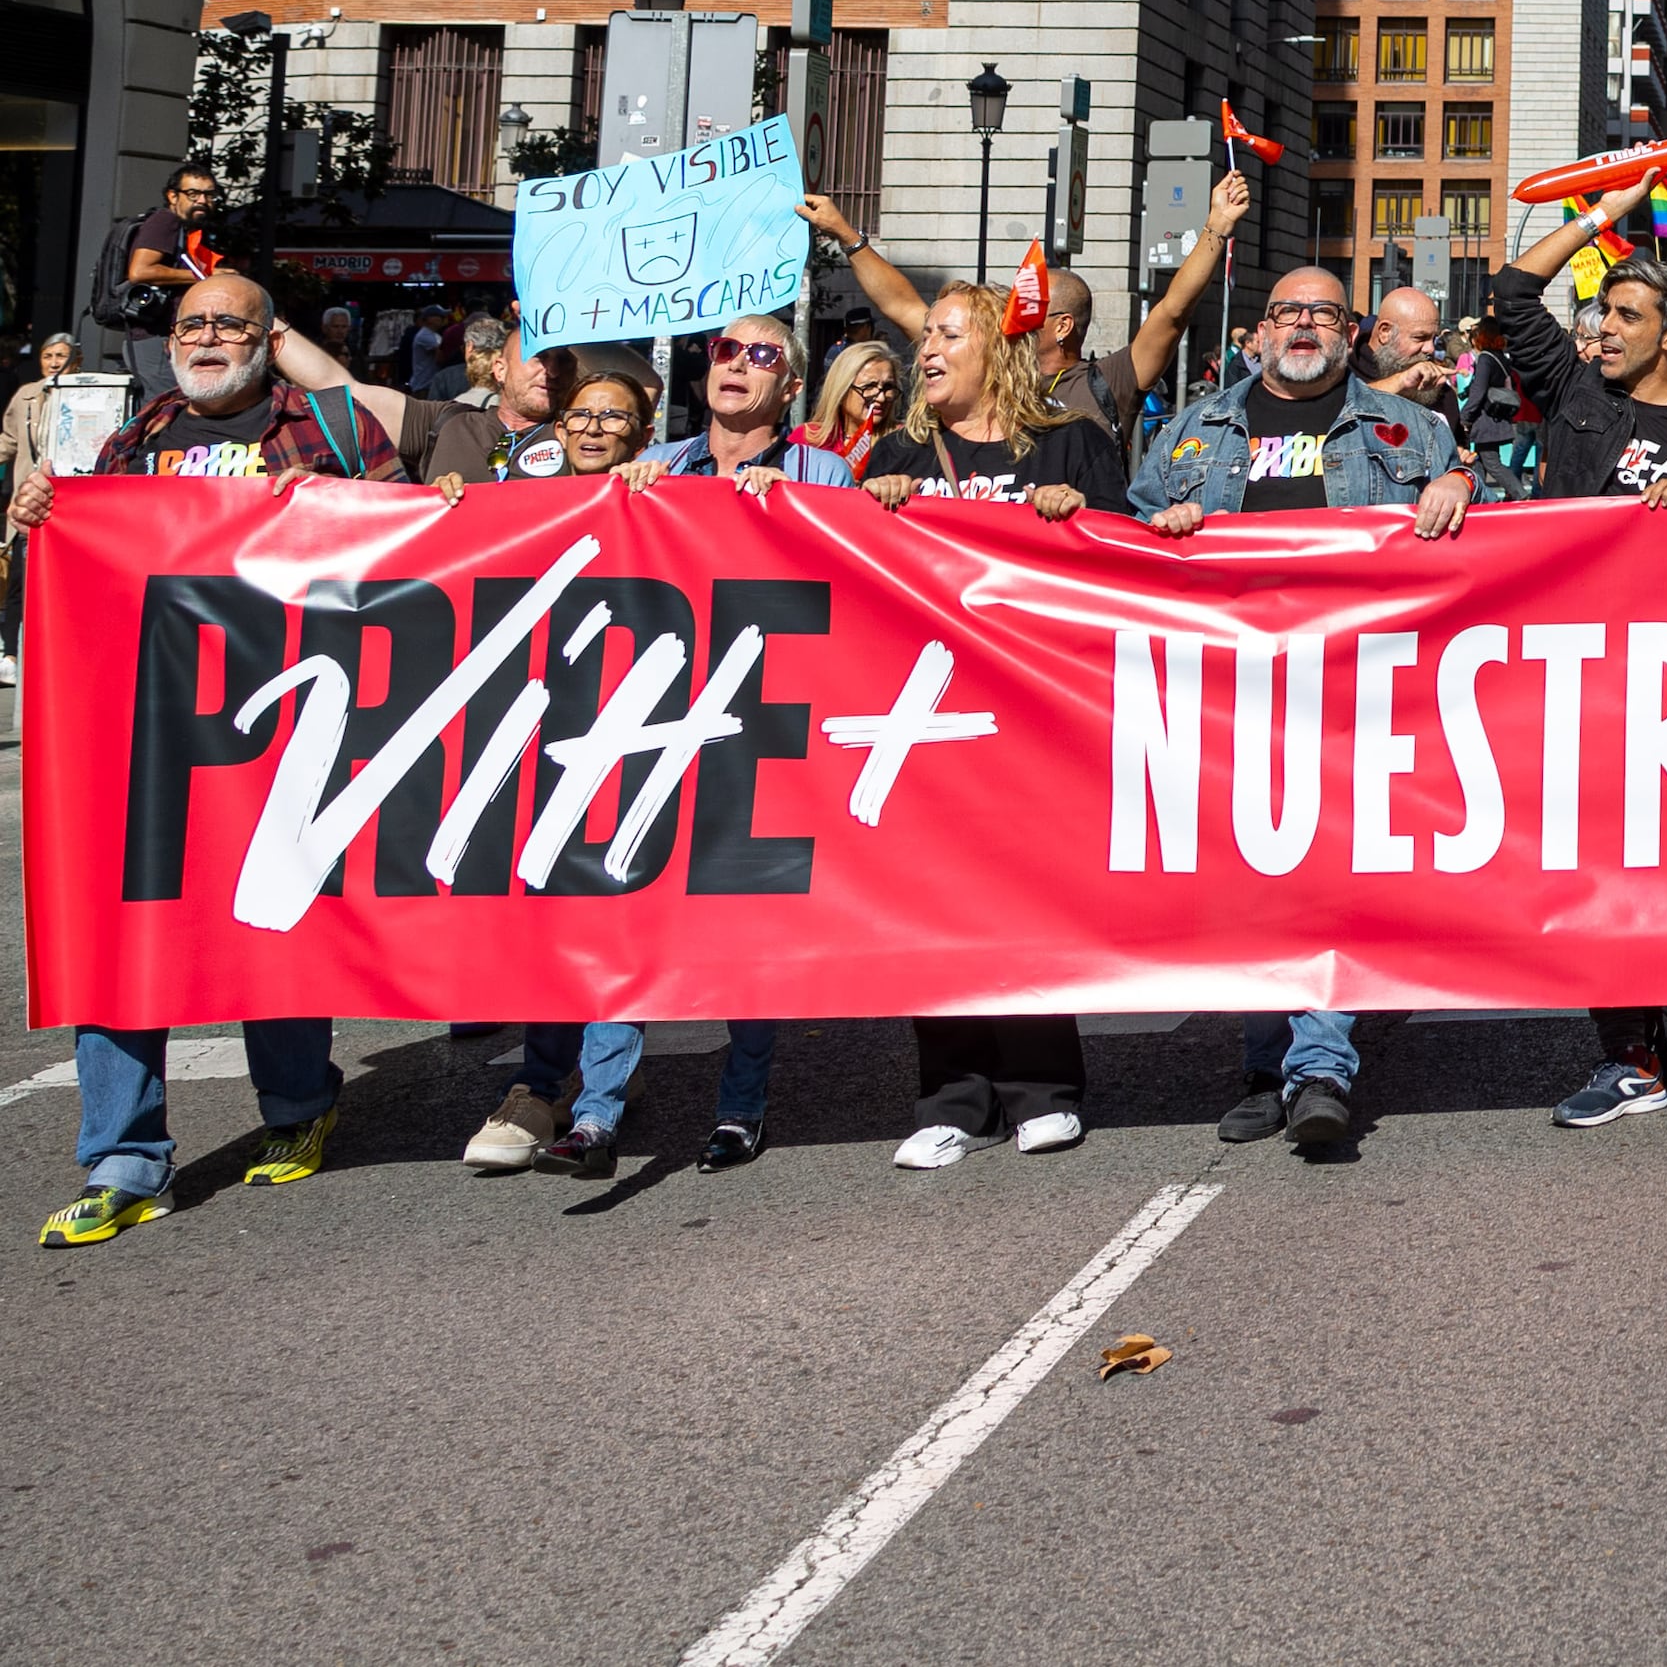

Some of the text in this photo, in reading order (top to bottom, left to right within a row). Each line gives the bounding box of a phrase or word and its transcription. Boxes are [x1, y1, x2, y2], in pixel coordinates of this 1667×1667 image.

[528, 165, 629, 215] SOY
[650, 122, 788, 194] VISIBLE
[313, 254, 372, 269] MADRID
[521, 258, 798, 346] NO + MASCARAS
[121, 573, 832, 903] PRIDE
